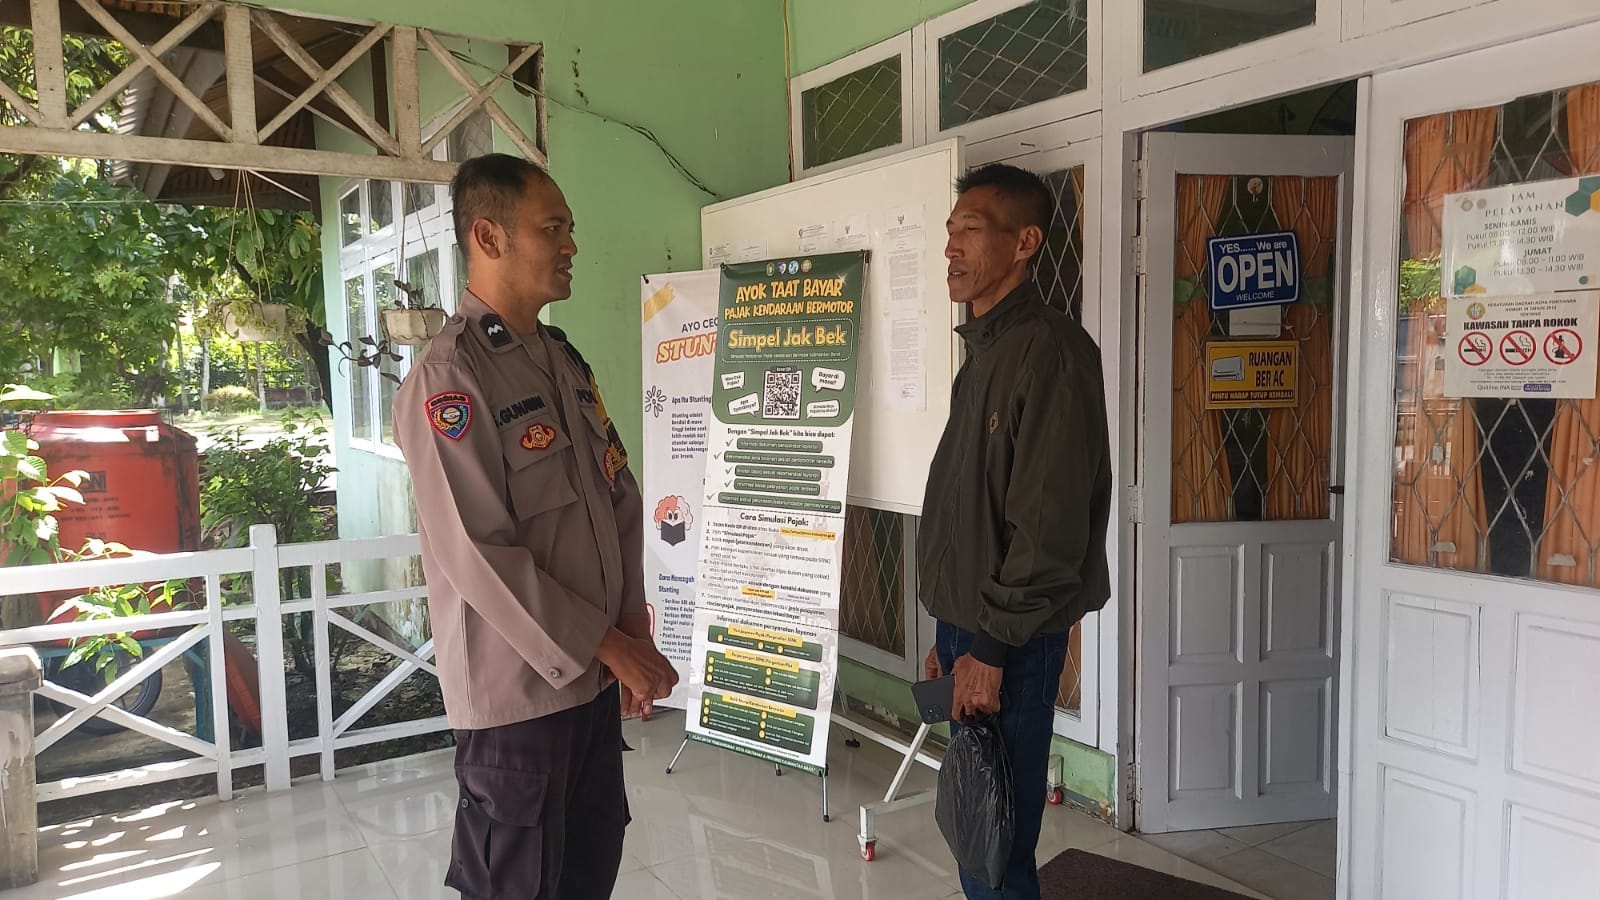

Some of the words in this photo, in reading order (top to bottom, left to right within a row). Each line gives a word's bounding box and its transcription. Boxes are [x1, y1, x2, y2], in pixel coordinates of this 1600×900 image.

[1511, 191, 1536, 203] JAM
[1485, 200, 1565, 217] PELAYANAN
[1484, 218, 1537, 231] SENIN-KAMIS
[1466, 232, 1487, 241] Pukul
[1518, 227, 1538, 236] 12.00
[1256, 241, 1271, 250] We
[1274, 241, 1287, 249] are
[1467, 241, 1488, 250] Pukul
[1516, 236, 1536, 245] 14.30
[1538, 234, 1554, 243] WIB
[1523, 247, 1552, 257] JUMAT
[1568, 254, 1585, 262] WIB
[1217, 250, 1294, 293] OPEN
[1567, 263, 1584, 271] WIB
[735, 283, 767, 304] AYOK
[771, 280, 800, 298] TAAT
[803, 278, 843, 297] BAYAR
[1236, 291, 1275, 301] WELCOME
[724, 306, 751, 320] PAJAK
[753, 301, 804, 316] KENDARAAN
[806, 300, 854, 315] BERMOTOR
[682, 321, 701, 334] AYO
[1463, 320, 1509, 331] KAWASAN
[1510, 319, 1541, 329] TANPA
[1543, 317, 1578, 328] ROKOK
[728, 327, 780, 352] Simpel
[783, 325, 813, 346] Jak
[815, 324, 848, 346] Bek
[1248, 351, 1292, 367] RUANGAN
[1255, 370, 1272, 387] BER
[1273, 370, 1285, 386] AC
[672, 396, 681, 405] Apa
[689, 395, 711, 404] Stunting
[727, 428, 747, 436] Dengan
[740, 512, 757, 521] Cara
[758, 514, 786, 524] Simulasi
[787, 517, 809, 527] Pajak:
[659, 573, 671, 582] Cara
[658, 585, 679, 595] Stunting
